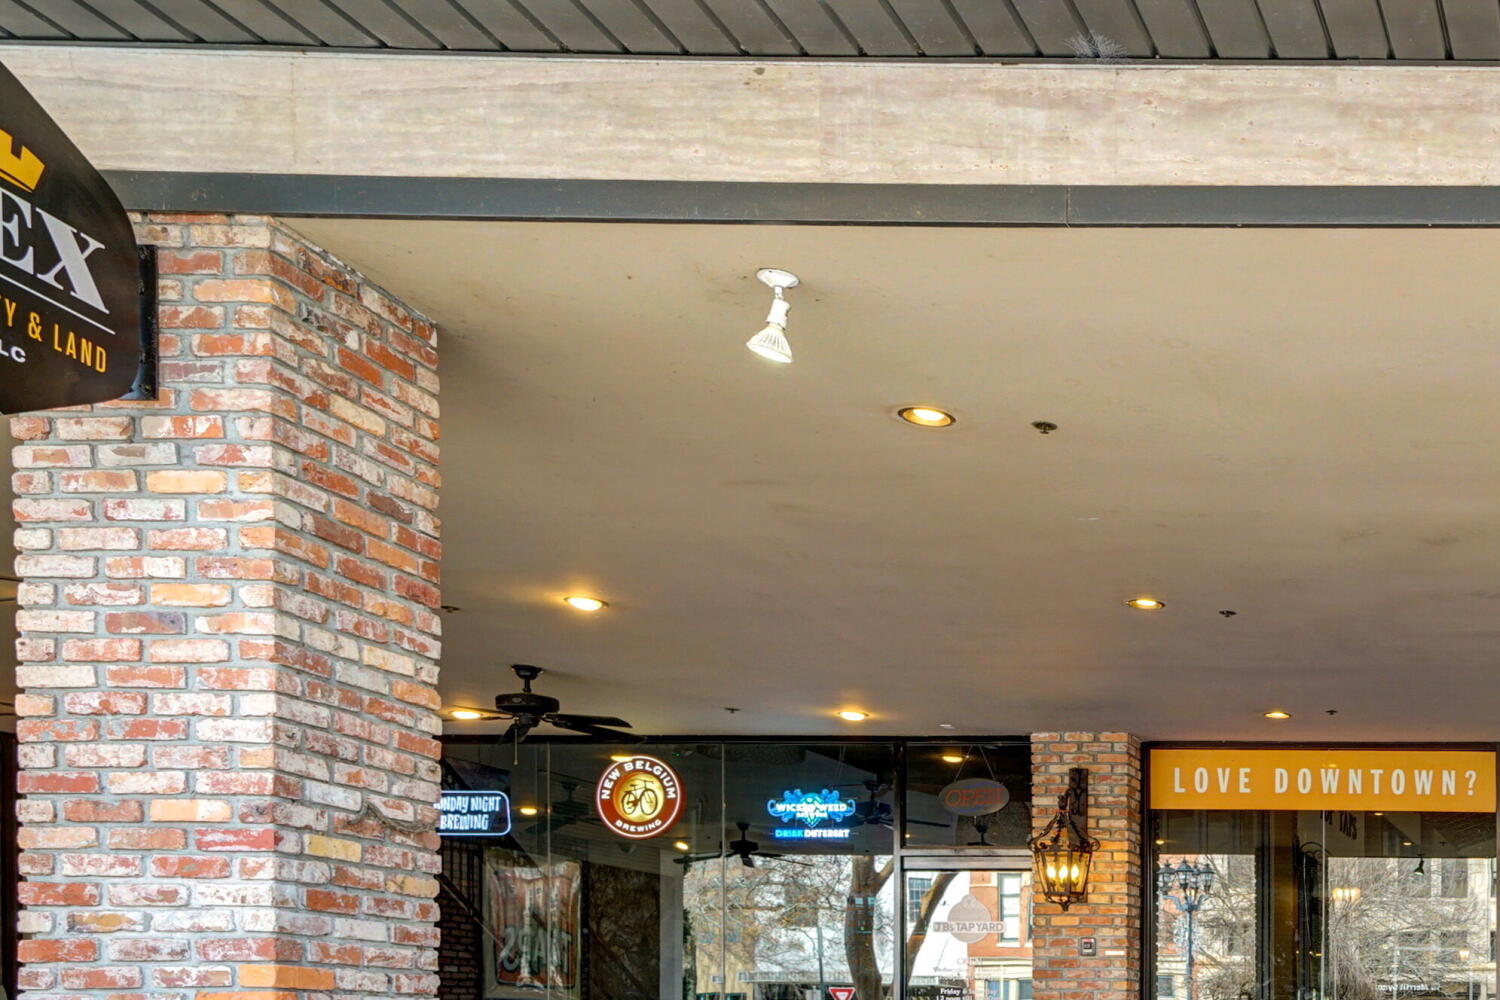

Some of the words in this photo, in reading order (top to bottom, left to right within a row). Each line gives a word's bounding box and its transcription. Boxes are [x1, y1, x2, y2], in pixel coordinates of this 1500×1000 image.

[28, 311, 42, 342] &
[54, 323, 107, 373] LAND
[600, 768, 621, 800] NEW
[623, 760, 677, 799] BELGIUM
[1174, 767, 1251, 793] LOVE
[1274, 768, 1477, 795] DOWNTOWN?
[470, 796, 501, 812] NIGHT
[944, 787, 1004, 808] OPEN
[440, 814, 489, 830] BREWING
[615, 819, 662, 832] BREWING
[940, 988, 961, 996] Friday
